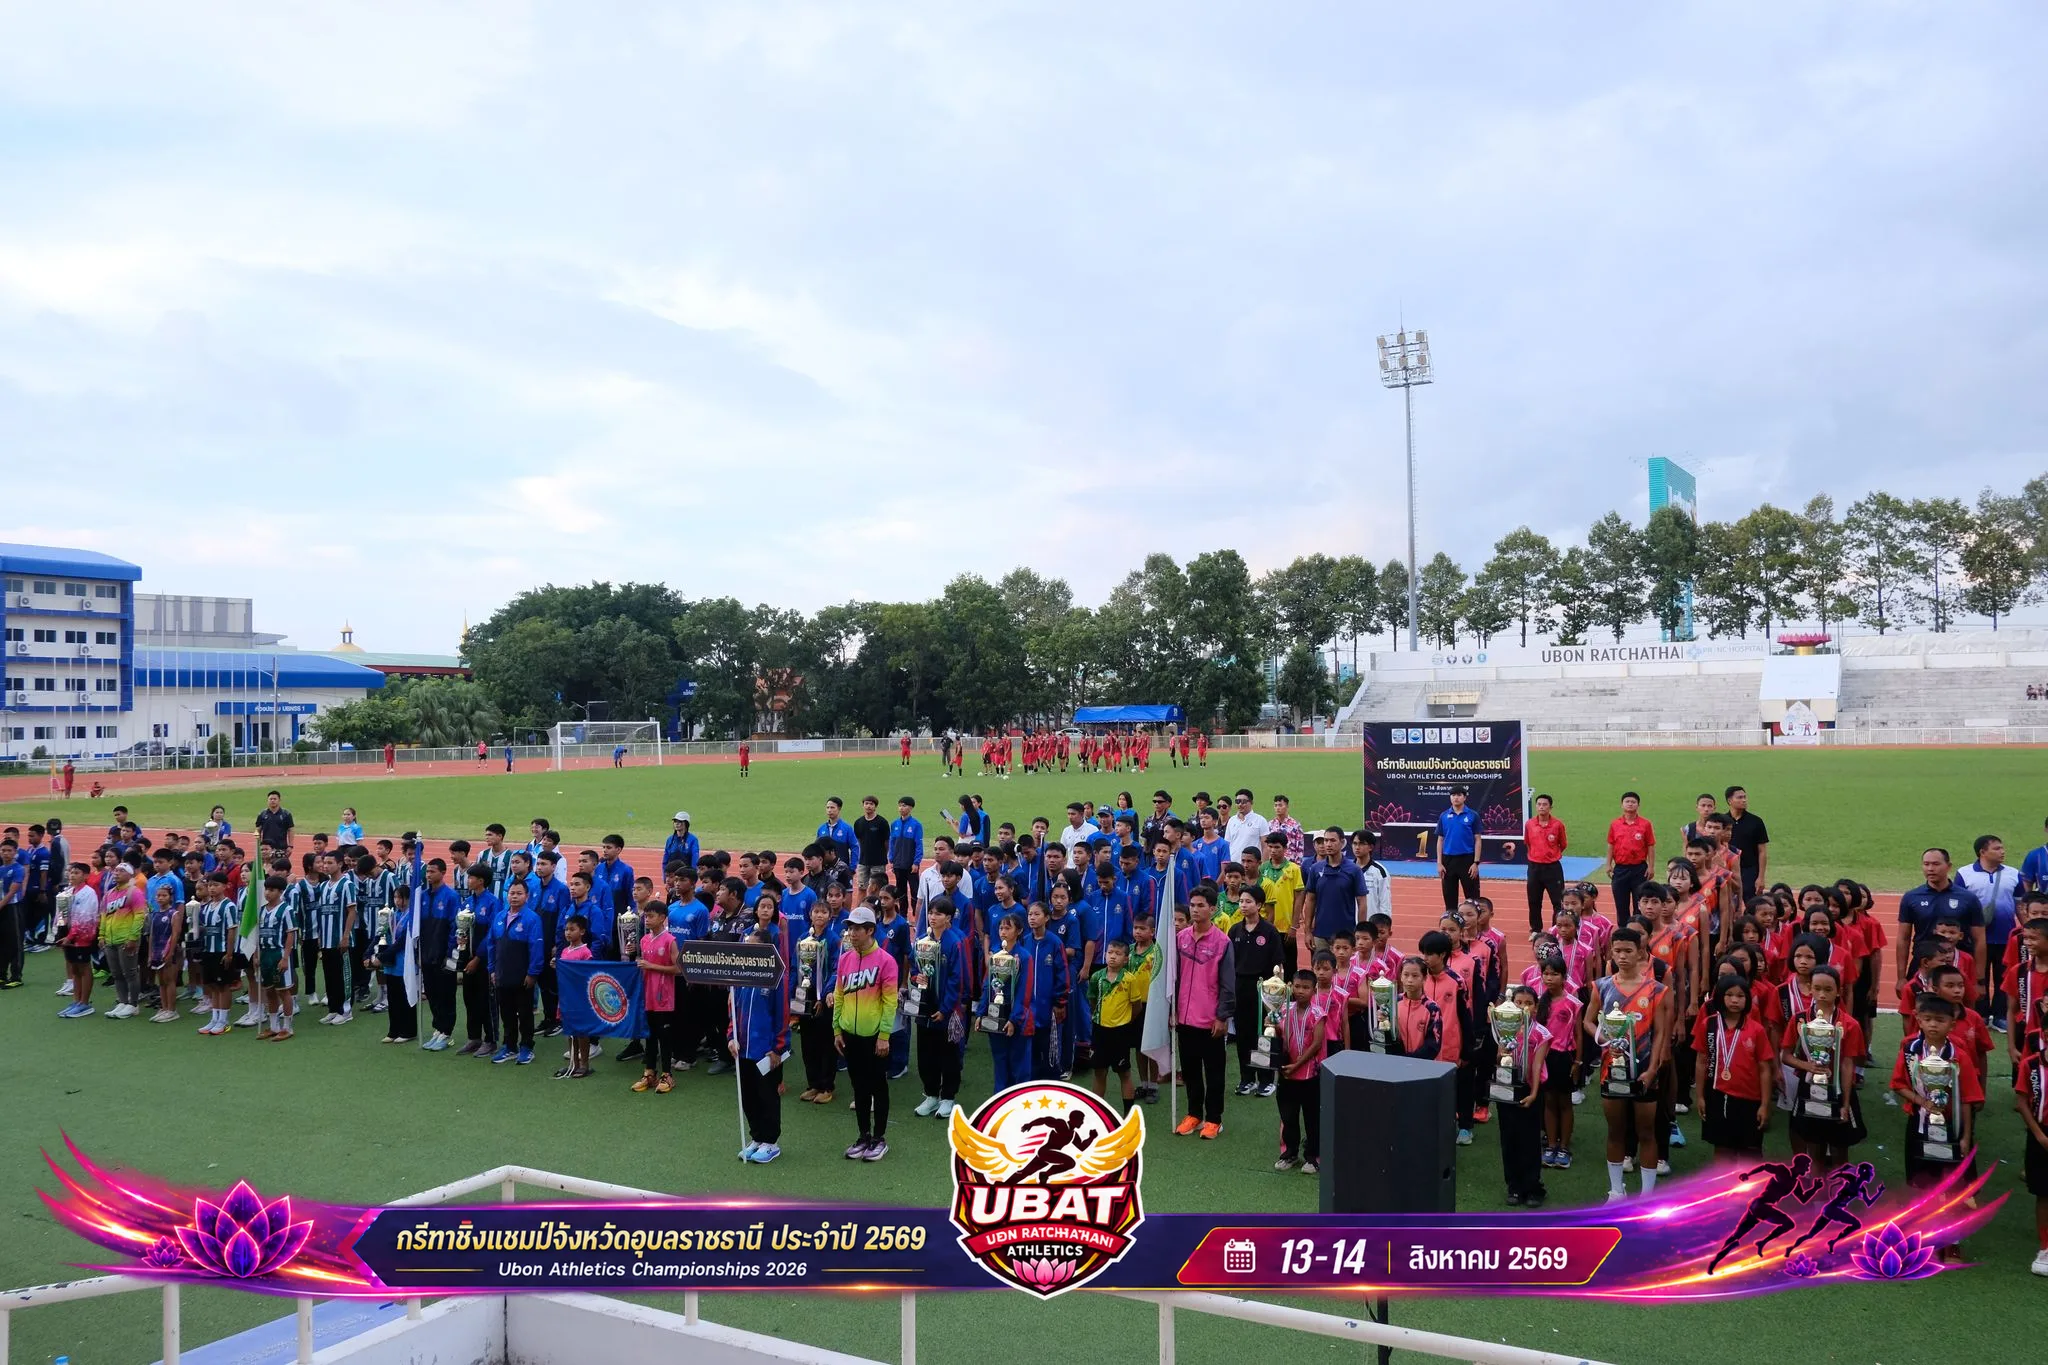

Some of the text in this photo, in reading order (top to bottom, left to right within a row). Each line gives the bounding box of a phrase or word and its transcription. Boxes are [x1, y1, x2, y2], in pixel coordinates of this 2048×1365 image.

[1541, 649, 1585, 663] UBON
[1416, 830, 1429, 858] 1
[1501, 841, 1516, 860] 3
[703, 968, 731, 976] ATHLETICS
[732, 970, 774, 978] CHAMPIONSHIPS
